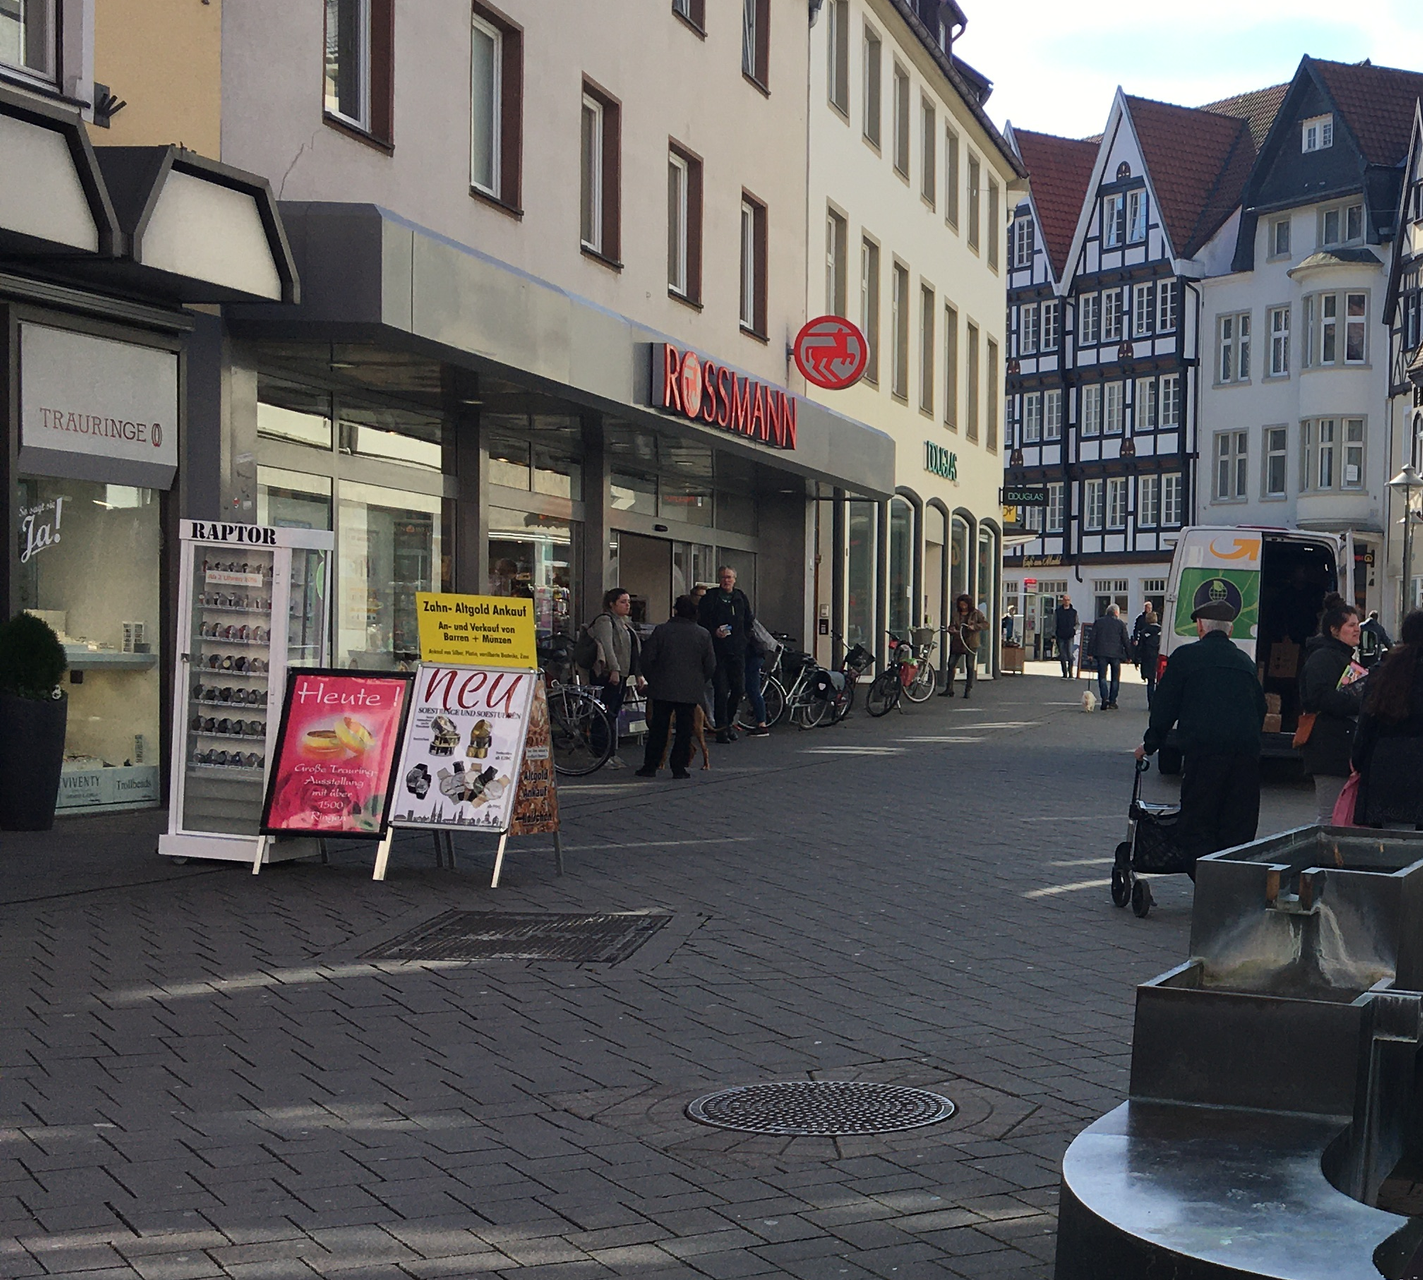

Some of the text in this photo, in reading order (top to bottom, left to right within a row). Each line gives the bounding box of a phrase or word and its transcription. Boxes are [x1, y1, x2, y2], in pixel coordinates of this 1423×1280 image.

[663, 342, 797, 450] ROSSMANN
[40, 407, 147, 443] TRAURINGE
[1007, 491, 1044, 502] DOUGLAS
[191, 522, 277, 545] RAPTOR
[423, 600, 527, 617] Zahn- Altgold Ankauf
[438, 621, 516, 634] An- und Verkauf von
[443, 632, 470, 642] Barren
[482, 634, 512, 644] Münzen
[297, 681, 382, 706] Heute
[424, 668, 524, 718] neu
[294, 763, 327, 774] Große
[62, 775, 100, 788] VIVENTY
[303, 775, 365, 789] Ausstellung
[312, 788, 353, 798] mit über
[318, 800, 344, 810] 1500
[310, 811, 347, 823] Ringen
